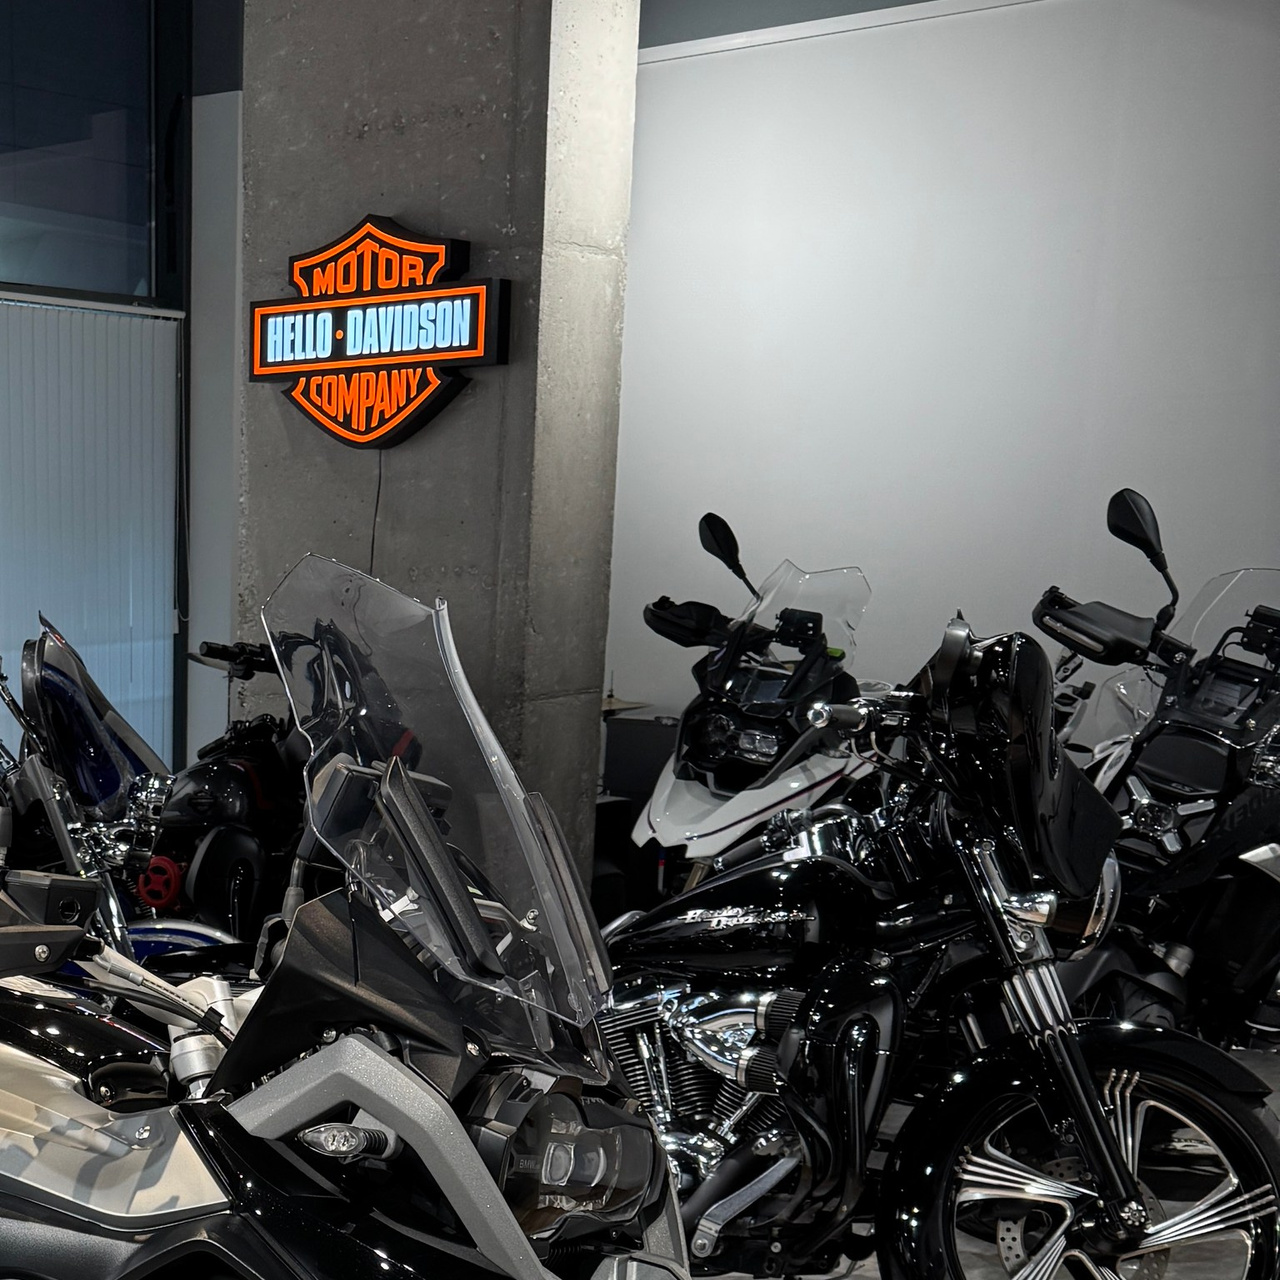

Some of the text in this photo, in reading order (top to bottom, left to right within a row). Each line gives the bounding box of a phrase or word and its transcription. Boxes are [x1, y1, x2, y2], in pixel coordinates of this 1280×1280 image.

[312, 238, 424, 296] MOTOR
[267, 299, 470, 362] HELLO DAVIDSON
[309, 367, 423, 431] COMPANY
